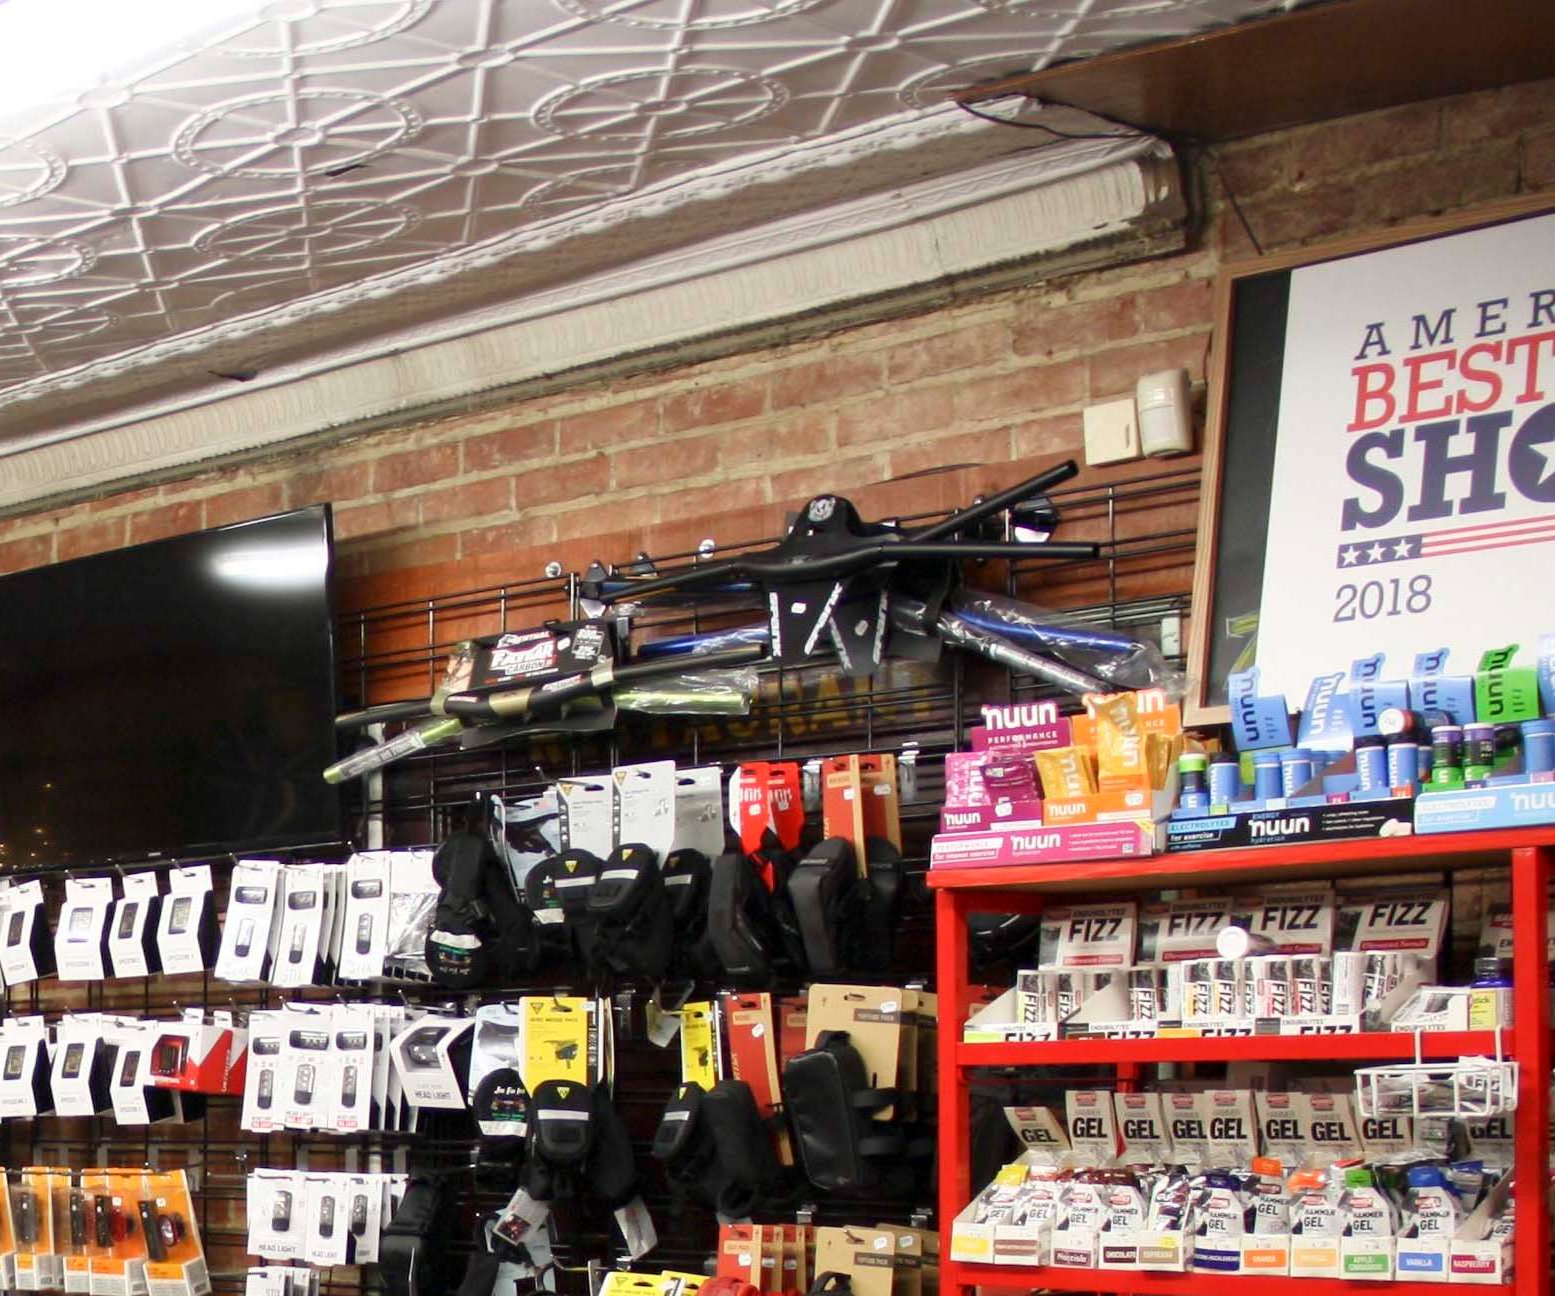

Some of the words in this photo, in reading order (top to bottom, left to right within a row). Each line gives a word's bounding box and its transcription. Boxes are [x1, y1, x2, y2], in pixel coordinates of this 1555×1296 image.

[1346, 328, 1555, 433] BEST
[1332, 573, 1433, 624] 2018
[1490, 648, 1509, 717] nuun
[981, 701, 1057, 731] nuun
[944, 812, 981, 826] nuun
[1048, 802, 1086, 817] nuun
[1170, 818, 1232, 832] ELECTROLYTES
[1248, 815, 1311, 837] nuun
[1010, 833, 1062, 851] nuun
[1170, 833, 1183, 842] for
[1184, 830, 1215, 841] exercise
[1168, 911, 1226, 937] FIZZ
[1260, 904, 1321, 932] FIZZ
[1367, 901, 1433, 928] FIZZ
[1068, 917, 1123, 944] FIZZ
[1139, 989, 1152, 1020] FIZZ
[1196, 983, 1208, 1018] FIZZ
[1219, 982, 1231, 1015] FIZZ
[1273, 983, 1286, 1015] FIZZ
[1300, 980, 1312, 1014] FIZZ
[1025, 993, 1037, 1024] FIZZ
[1021, 1128, 1058, 1143] GEL
[1073, 1117, 1108, 1138] GEL
[1124, 1119, 1160, 1139] GEL
[1173, 1119, 1207, 1139] GEL
[1211, 1117, 1247, 1139] GEL
[1266, 1119, 1305, 1140] GEL
[1311, 1121, 1352, 1141] GEL
[1363, 1119, 1404, 1139] GEL
[1470, 1117, 1513, 1139] GEL
[1029, 1209, 1047, 1219] GEL
[1070, 1214, 1087, 1224] GEL
[1258, 1203, 1279, 1216] GEL
[1112, 1215, 1129, 1226] GEL
[1208, 1219, 1227, 1230] GEL
[1304, 1216, 1325, 1228] GEL
[1353, 1219, 1374, 1231] GEL
[1420, 1219, 1440, 1231] GEL
[1452, 1260, 1491, 1269] RASPBERRY
